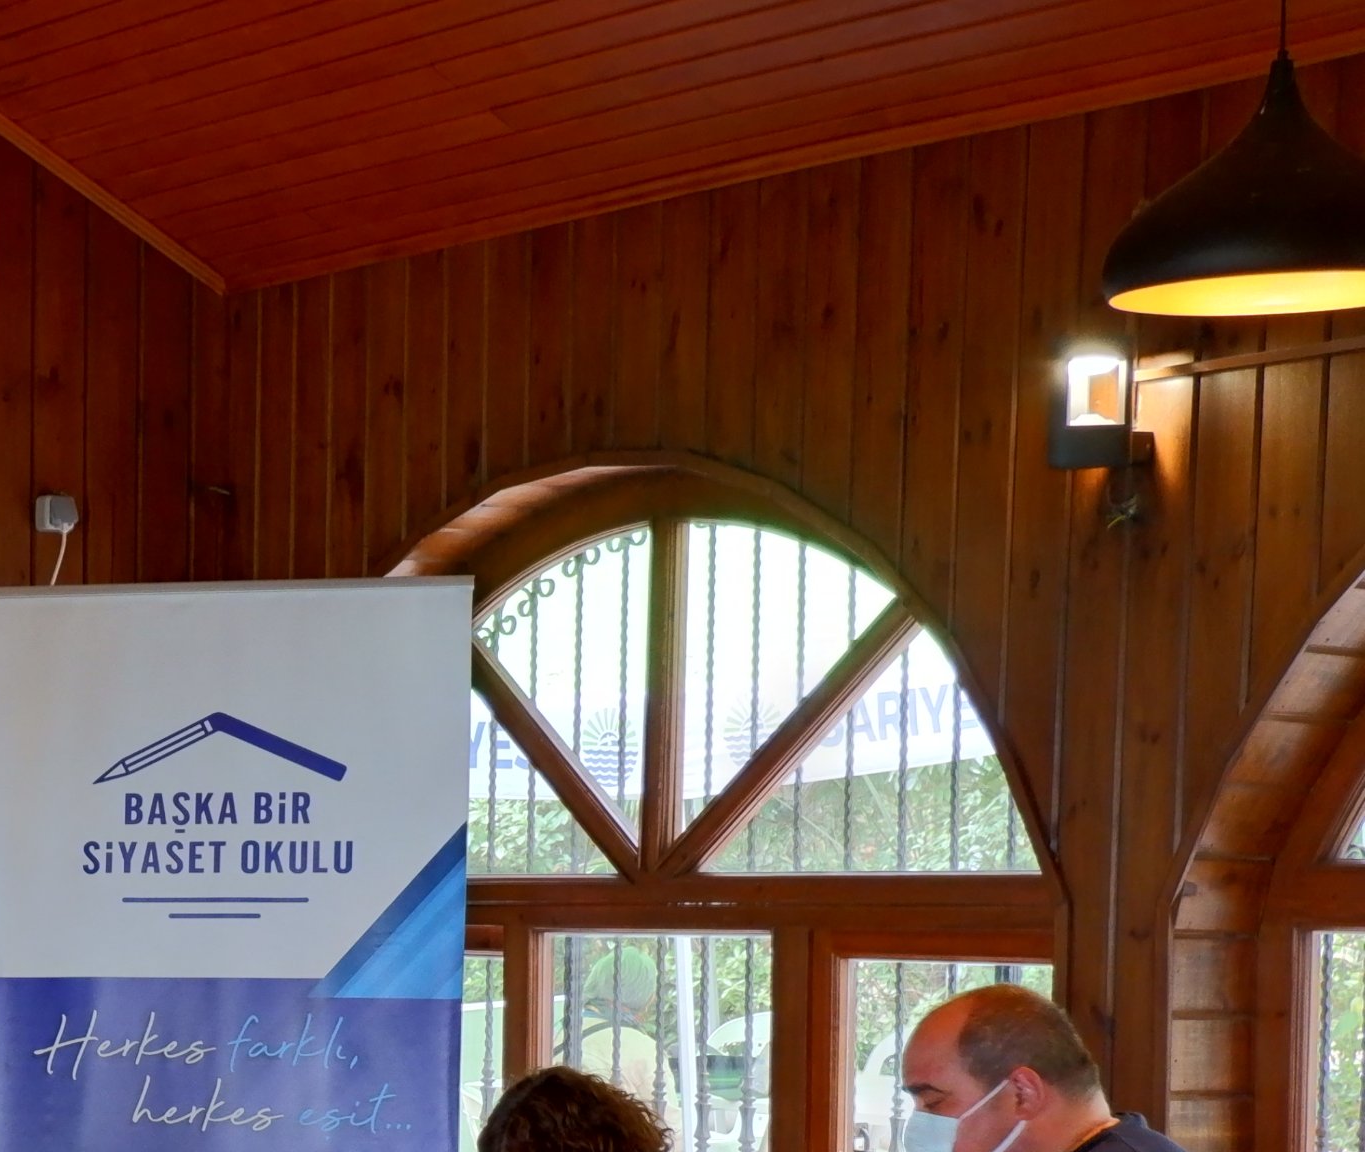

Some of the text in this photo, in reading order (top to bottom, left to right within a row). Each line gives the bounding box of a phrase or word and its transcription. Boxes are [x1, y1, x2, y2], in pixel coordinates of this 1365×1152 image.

[124, 791, 238, 833] BAŞKA
[240, 839, 354, 874] OKULU
[33, 1010, 359, 1081] Herkes farklı,
[131, 1075, 284, 1132] herkes
